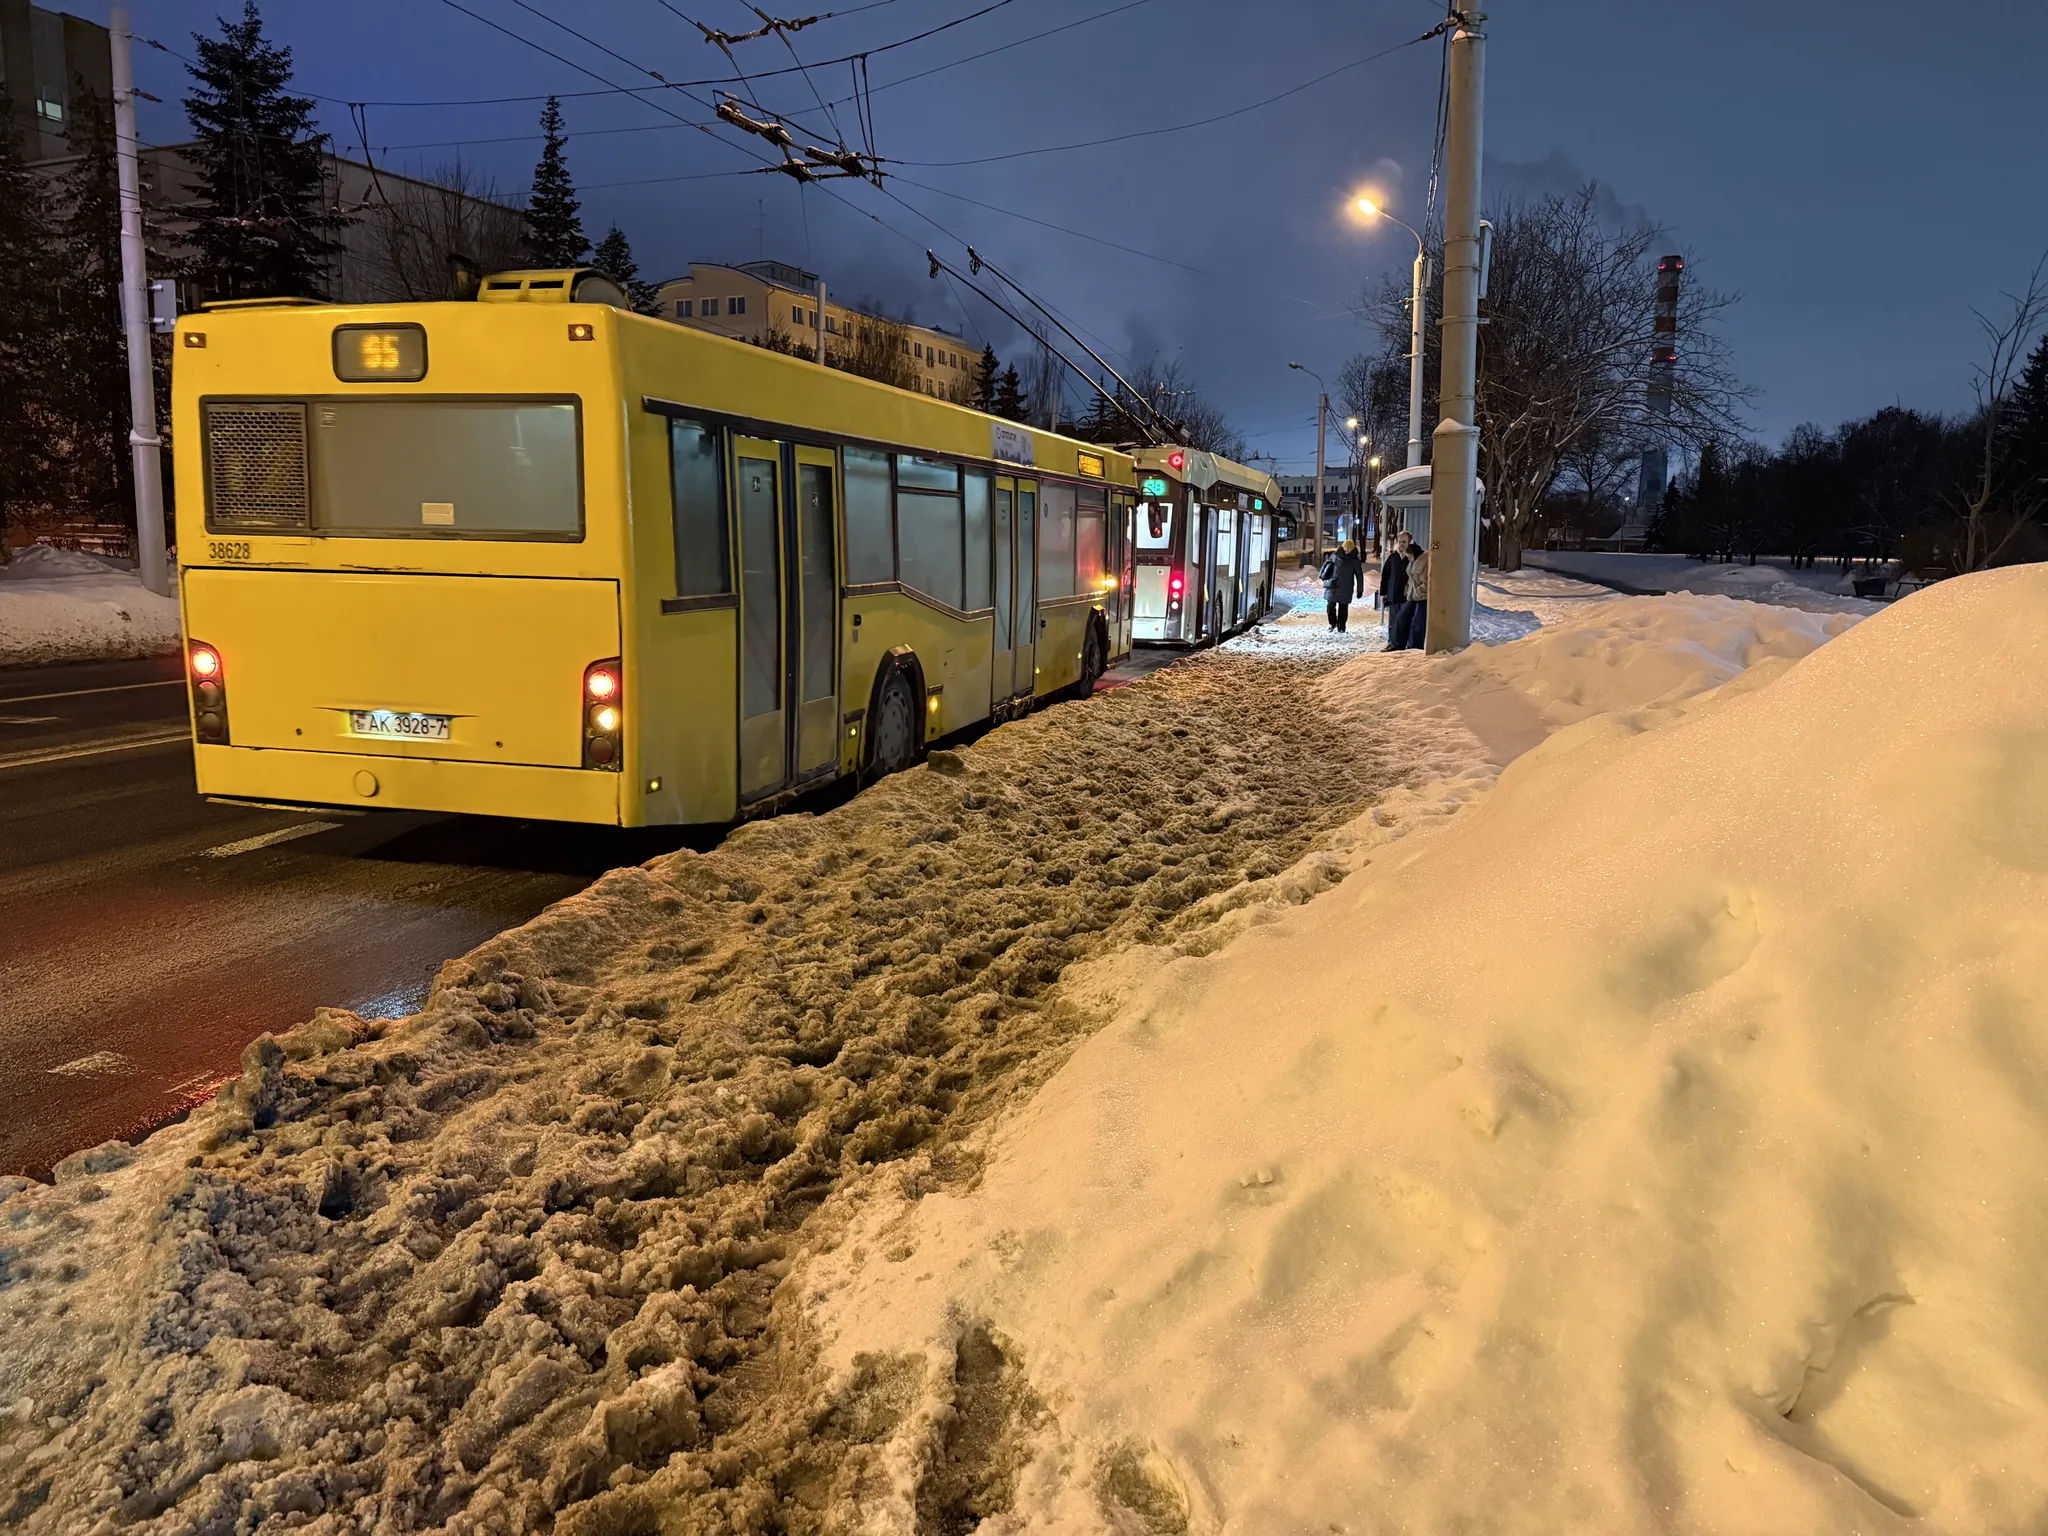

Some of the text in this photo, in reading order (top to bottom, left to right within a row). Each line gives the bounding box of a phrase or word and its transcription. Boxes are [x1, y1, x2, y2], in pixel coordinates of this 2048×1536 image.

[209, 542, 250, 559] 38628
[369, 714, 390, 733] AK
[394, 716, 445, 736] 3928-7
